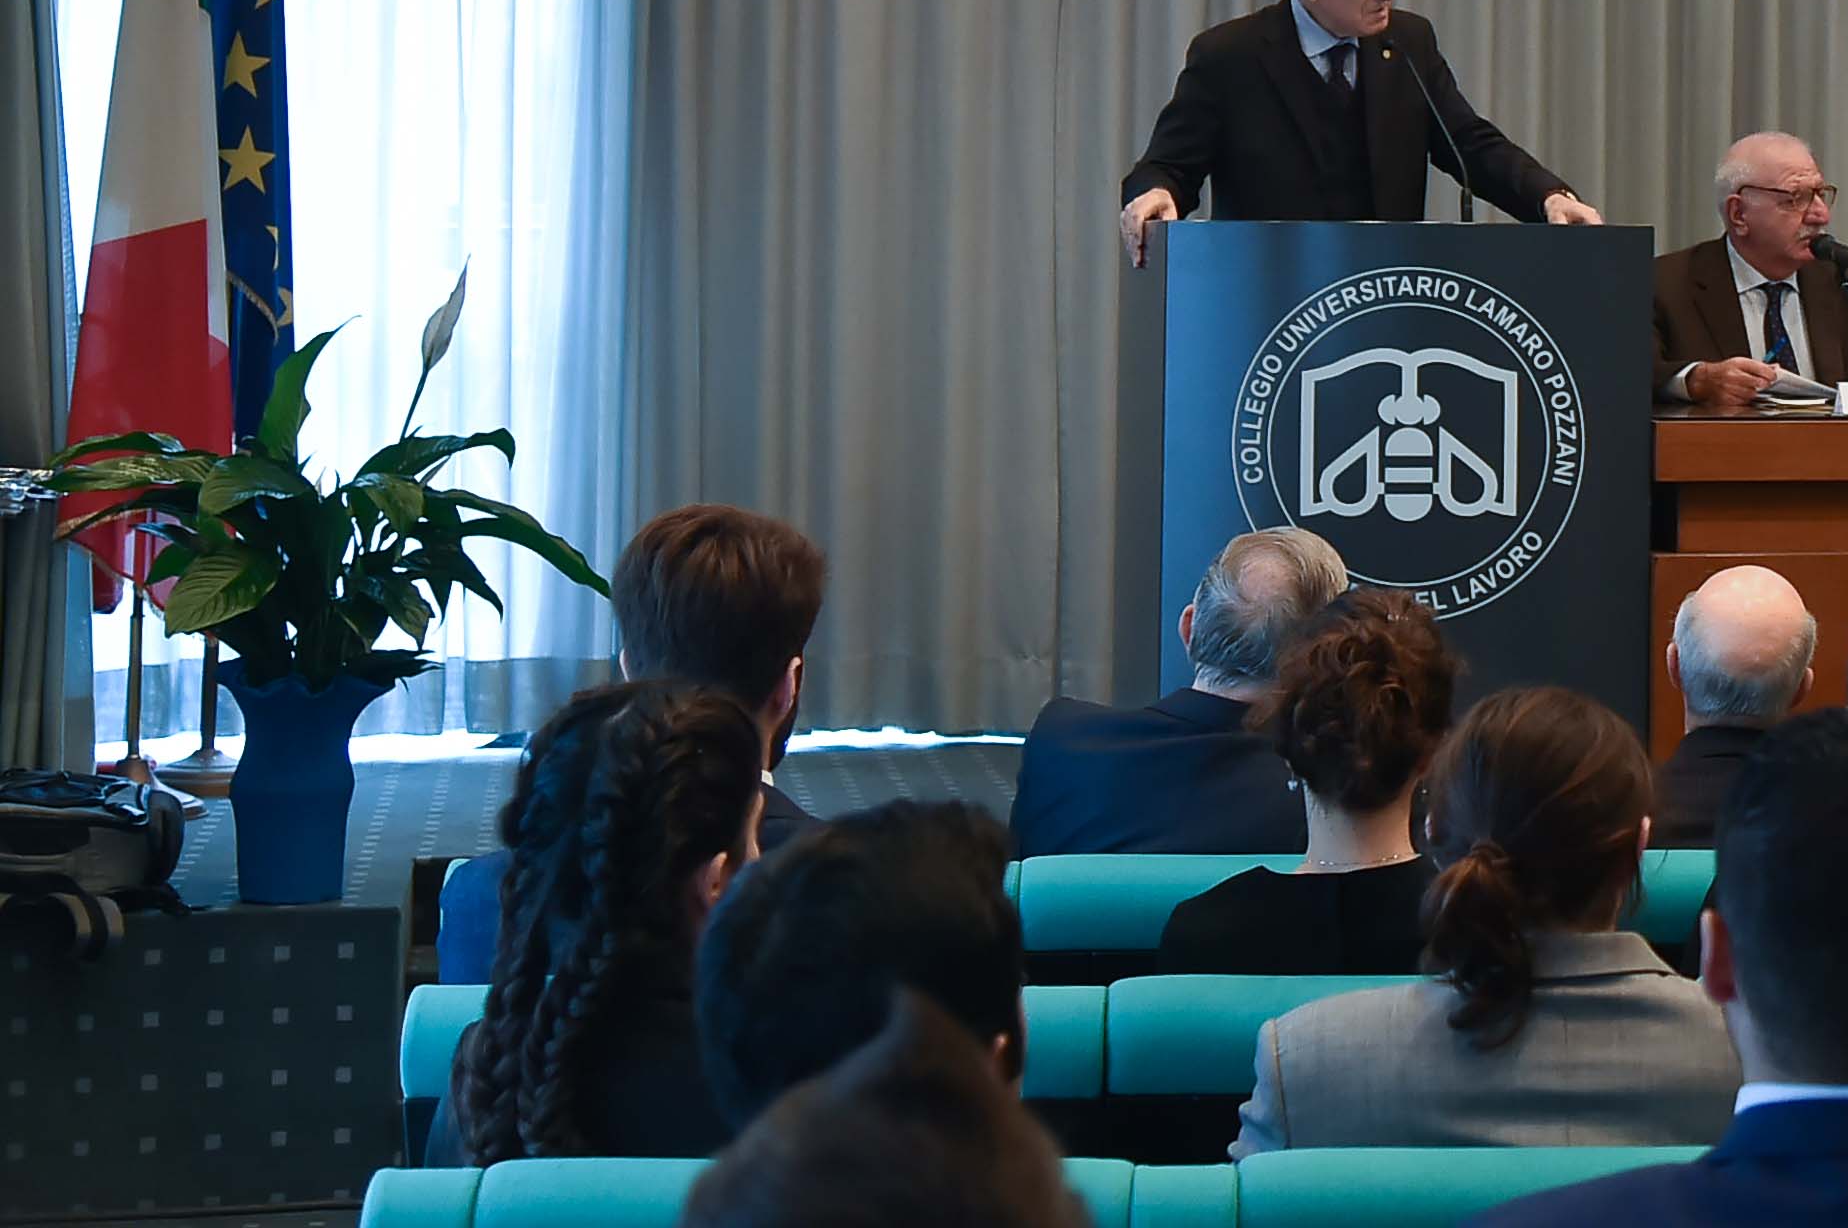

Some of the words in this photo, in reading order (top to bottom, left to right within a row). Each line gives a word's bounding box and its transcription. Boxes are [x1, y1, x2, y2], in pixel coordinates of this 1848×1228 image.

[1242, 354, 1284, 484] COLLEGIO
[1276, 274, 1461, 354] UNIVERSITARIO
[1464, 287, 1555, 372] LAMARO
[1544, 374, 1578, 487] POZZANI
[1415, 590, 1448, 610] EL
[1451, 529, 1544, 604] LAVORO
